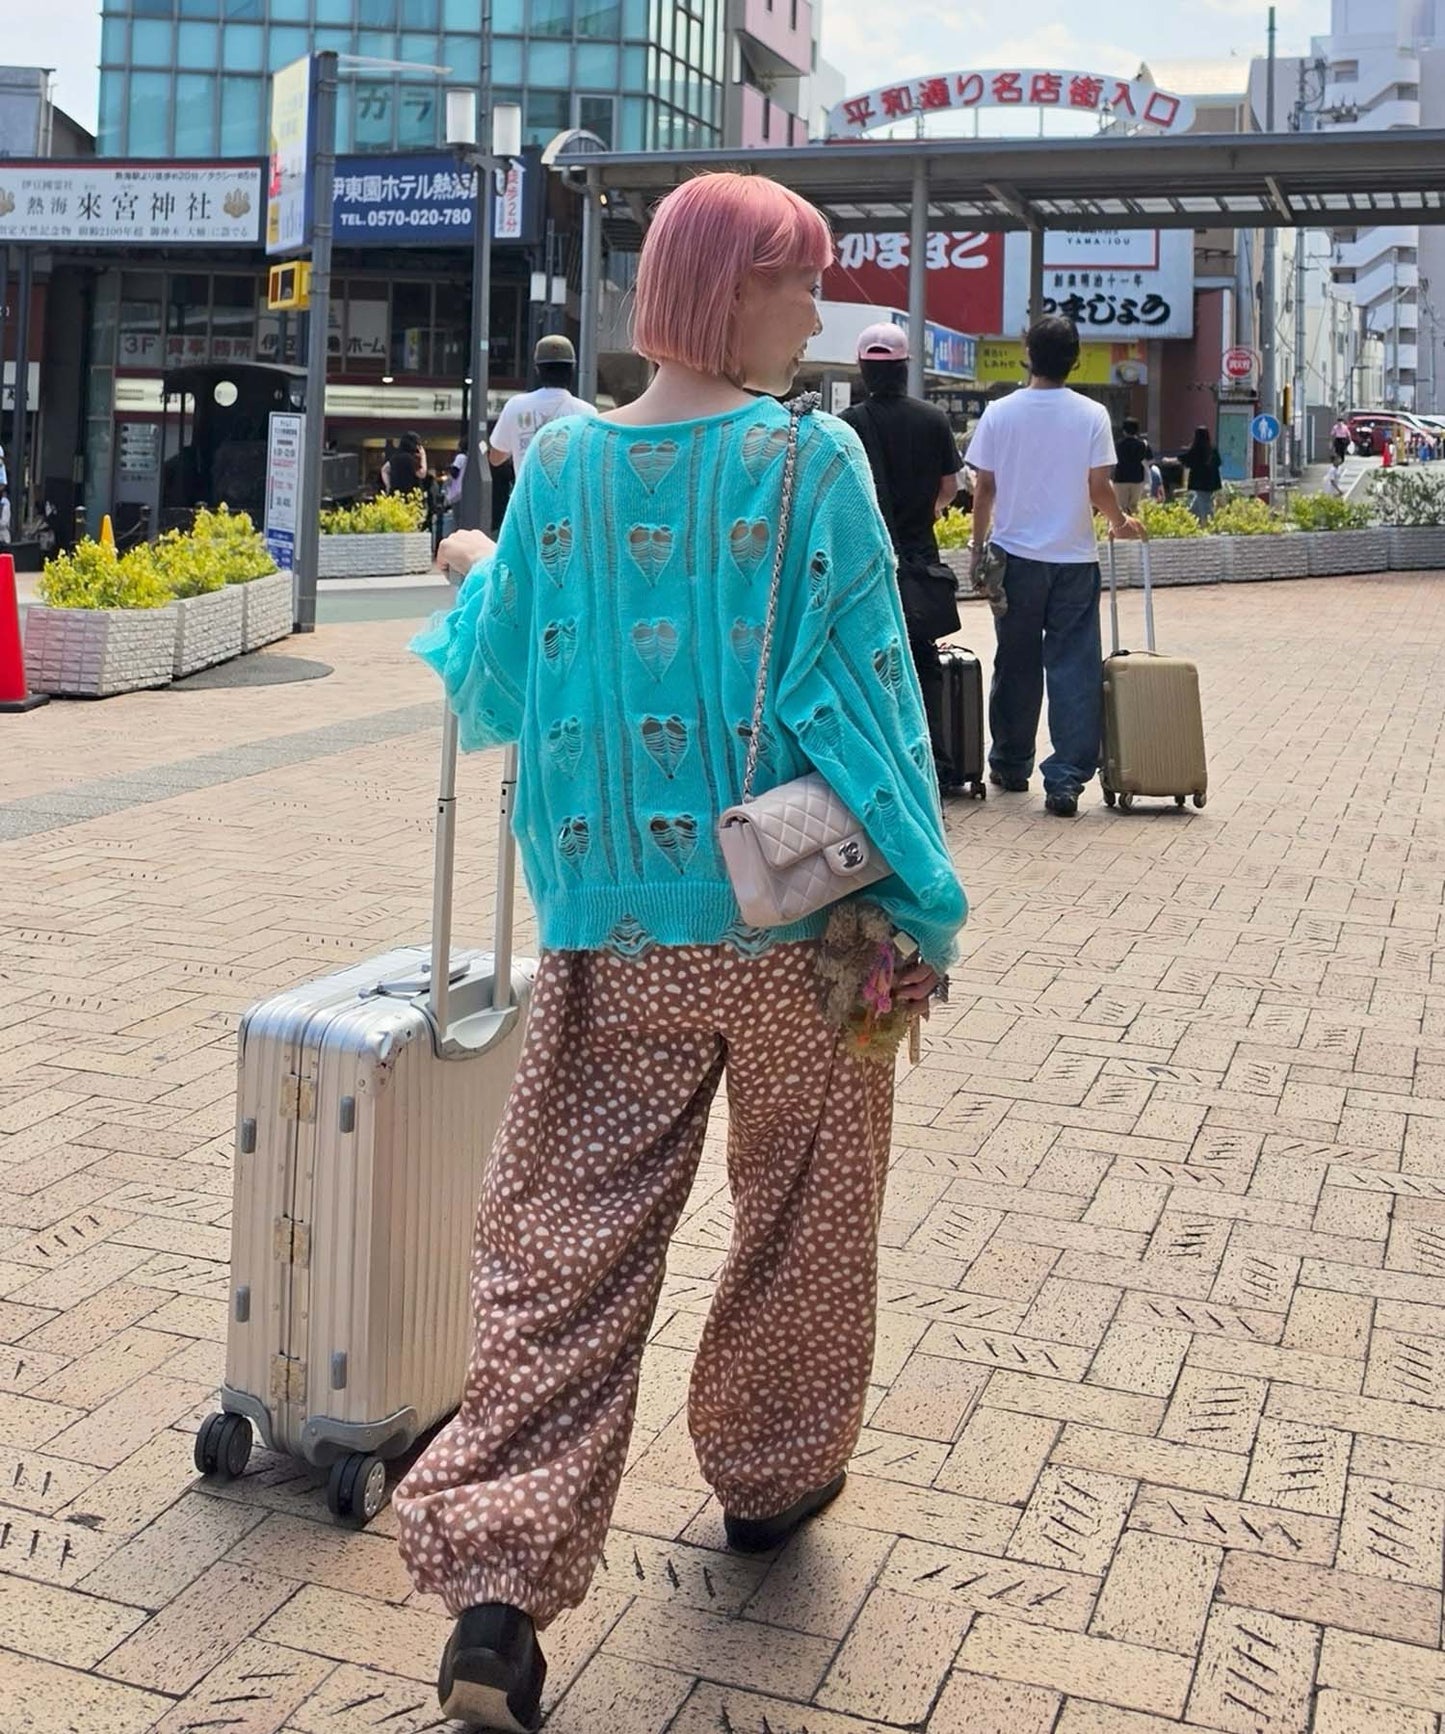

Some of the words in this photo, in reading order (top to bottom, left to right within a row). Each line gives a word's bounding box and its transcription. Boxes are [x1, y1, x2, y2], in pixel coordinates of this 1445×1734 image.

[843, 72, 1181, 128] 平和通り名店街入口
[333, 172, 478, 203] 伊東園ホテル熱海
[78, 191, 212, 221] 來宮神社
[125, 337, 155, 353] 3F
